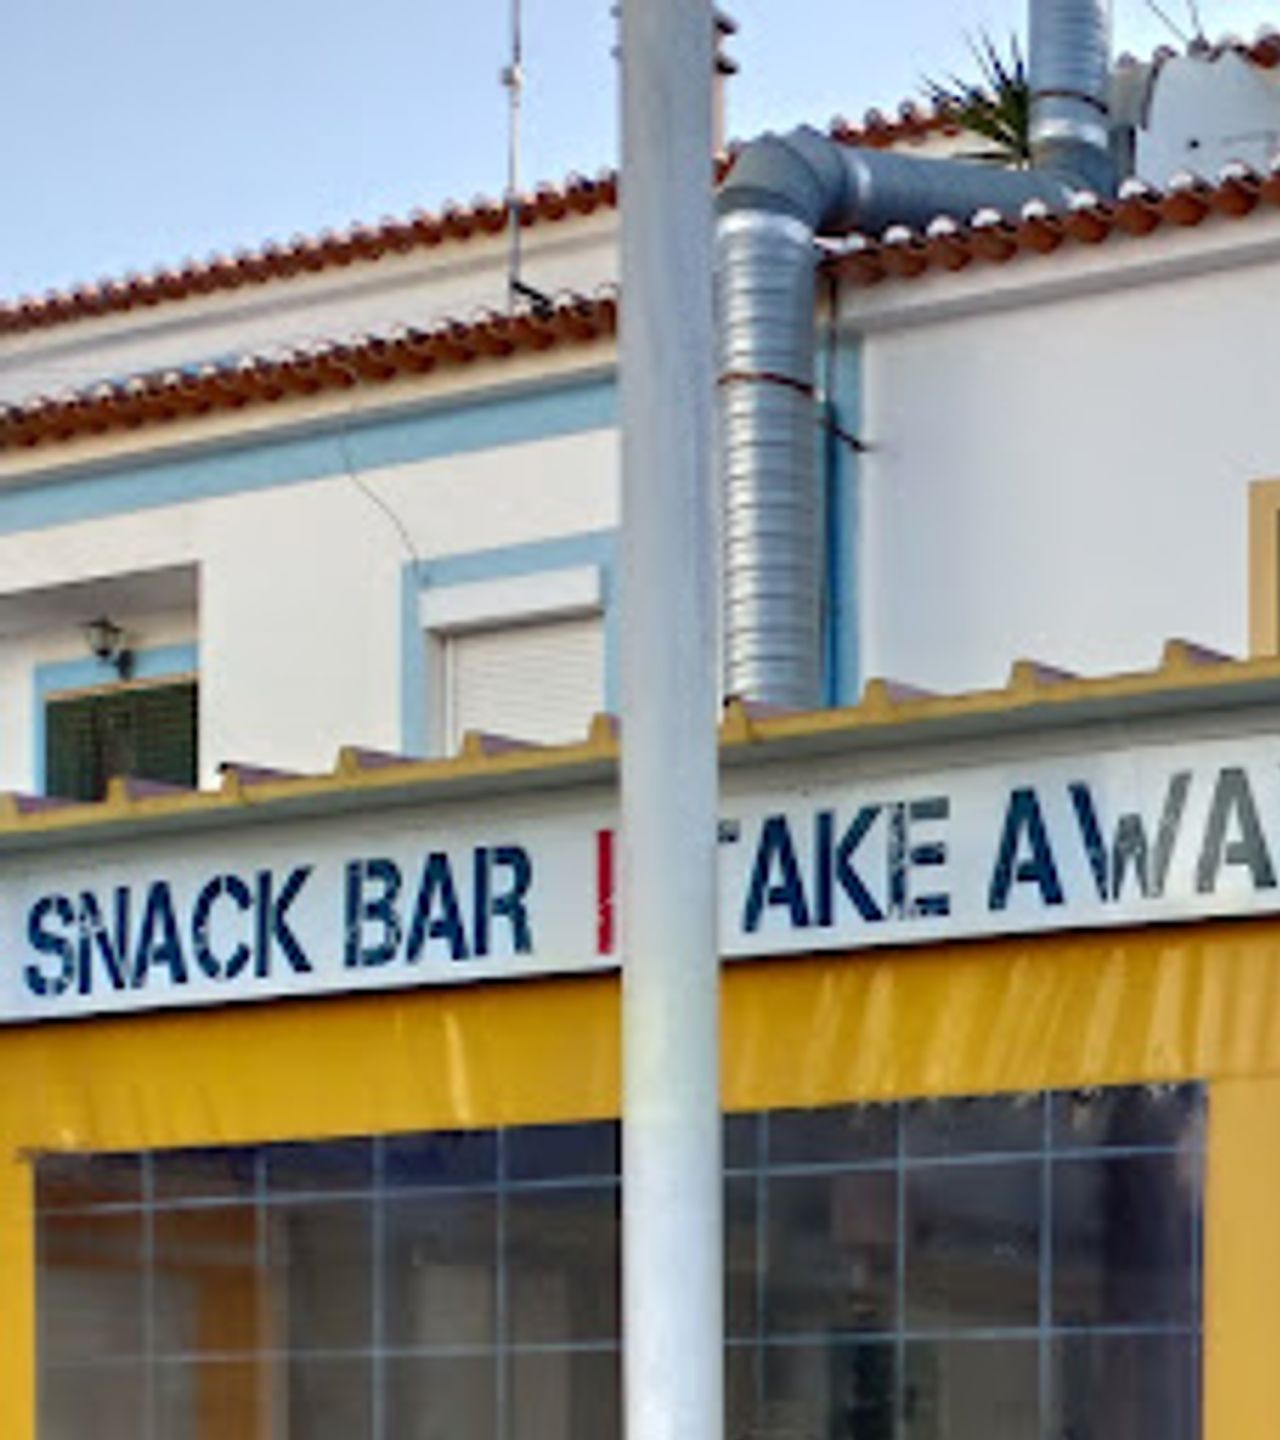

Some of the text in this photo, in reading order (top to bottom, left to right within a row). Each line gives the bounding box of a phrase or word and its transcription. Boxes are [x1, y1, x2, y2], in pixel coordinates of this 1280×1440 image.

[23, 864, 315, 996] SNACK
[343, 844, 533, 968] BAR
[716, 798, 951, 934] AKE
